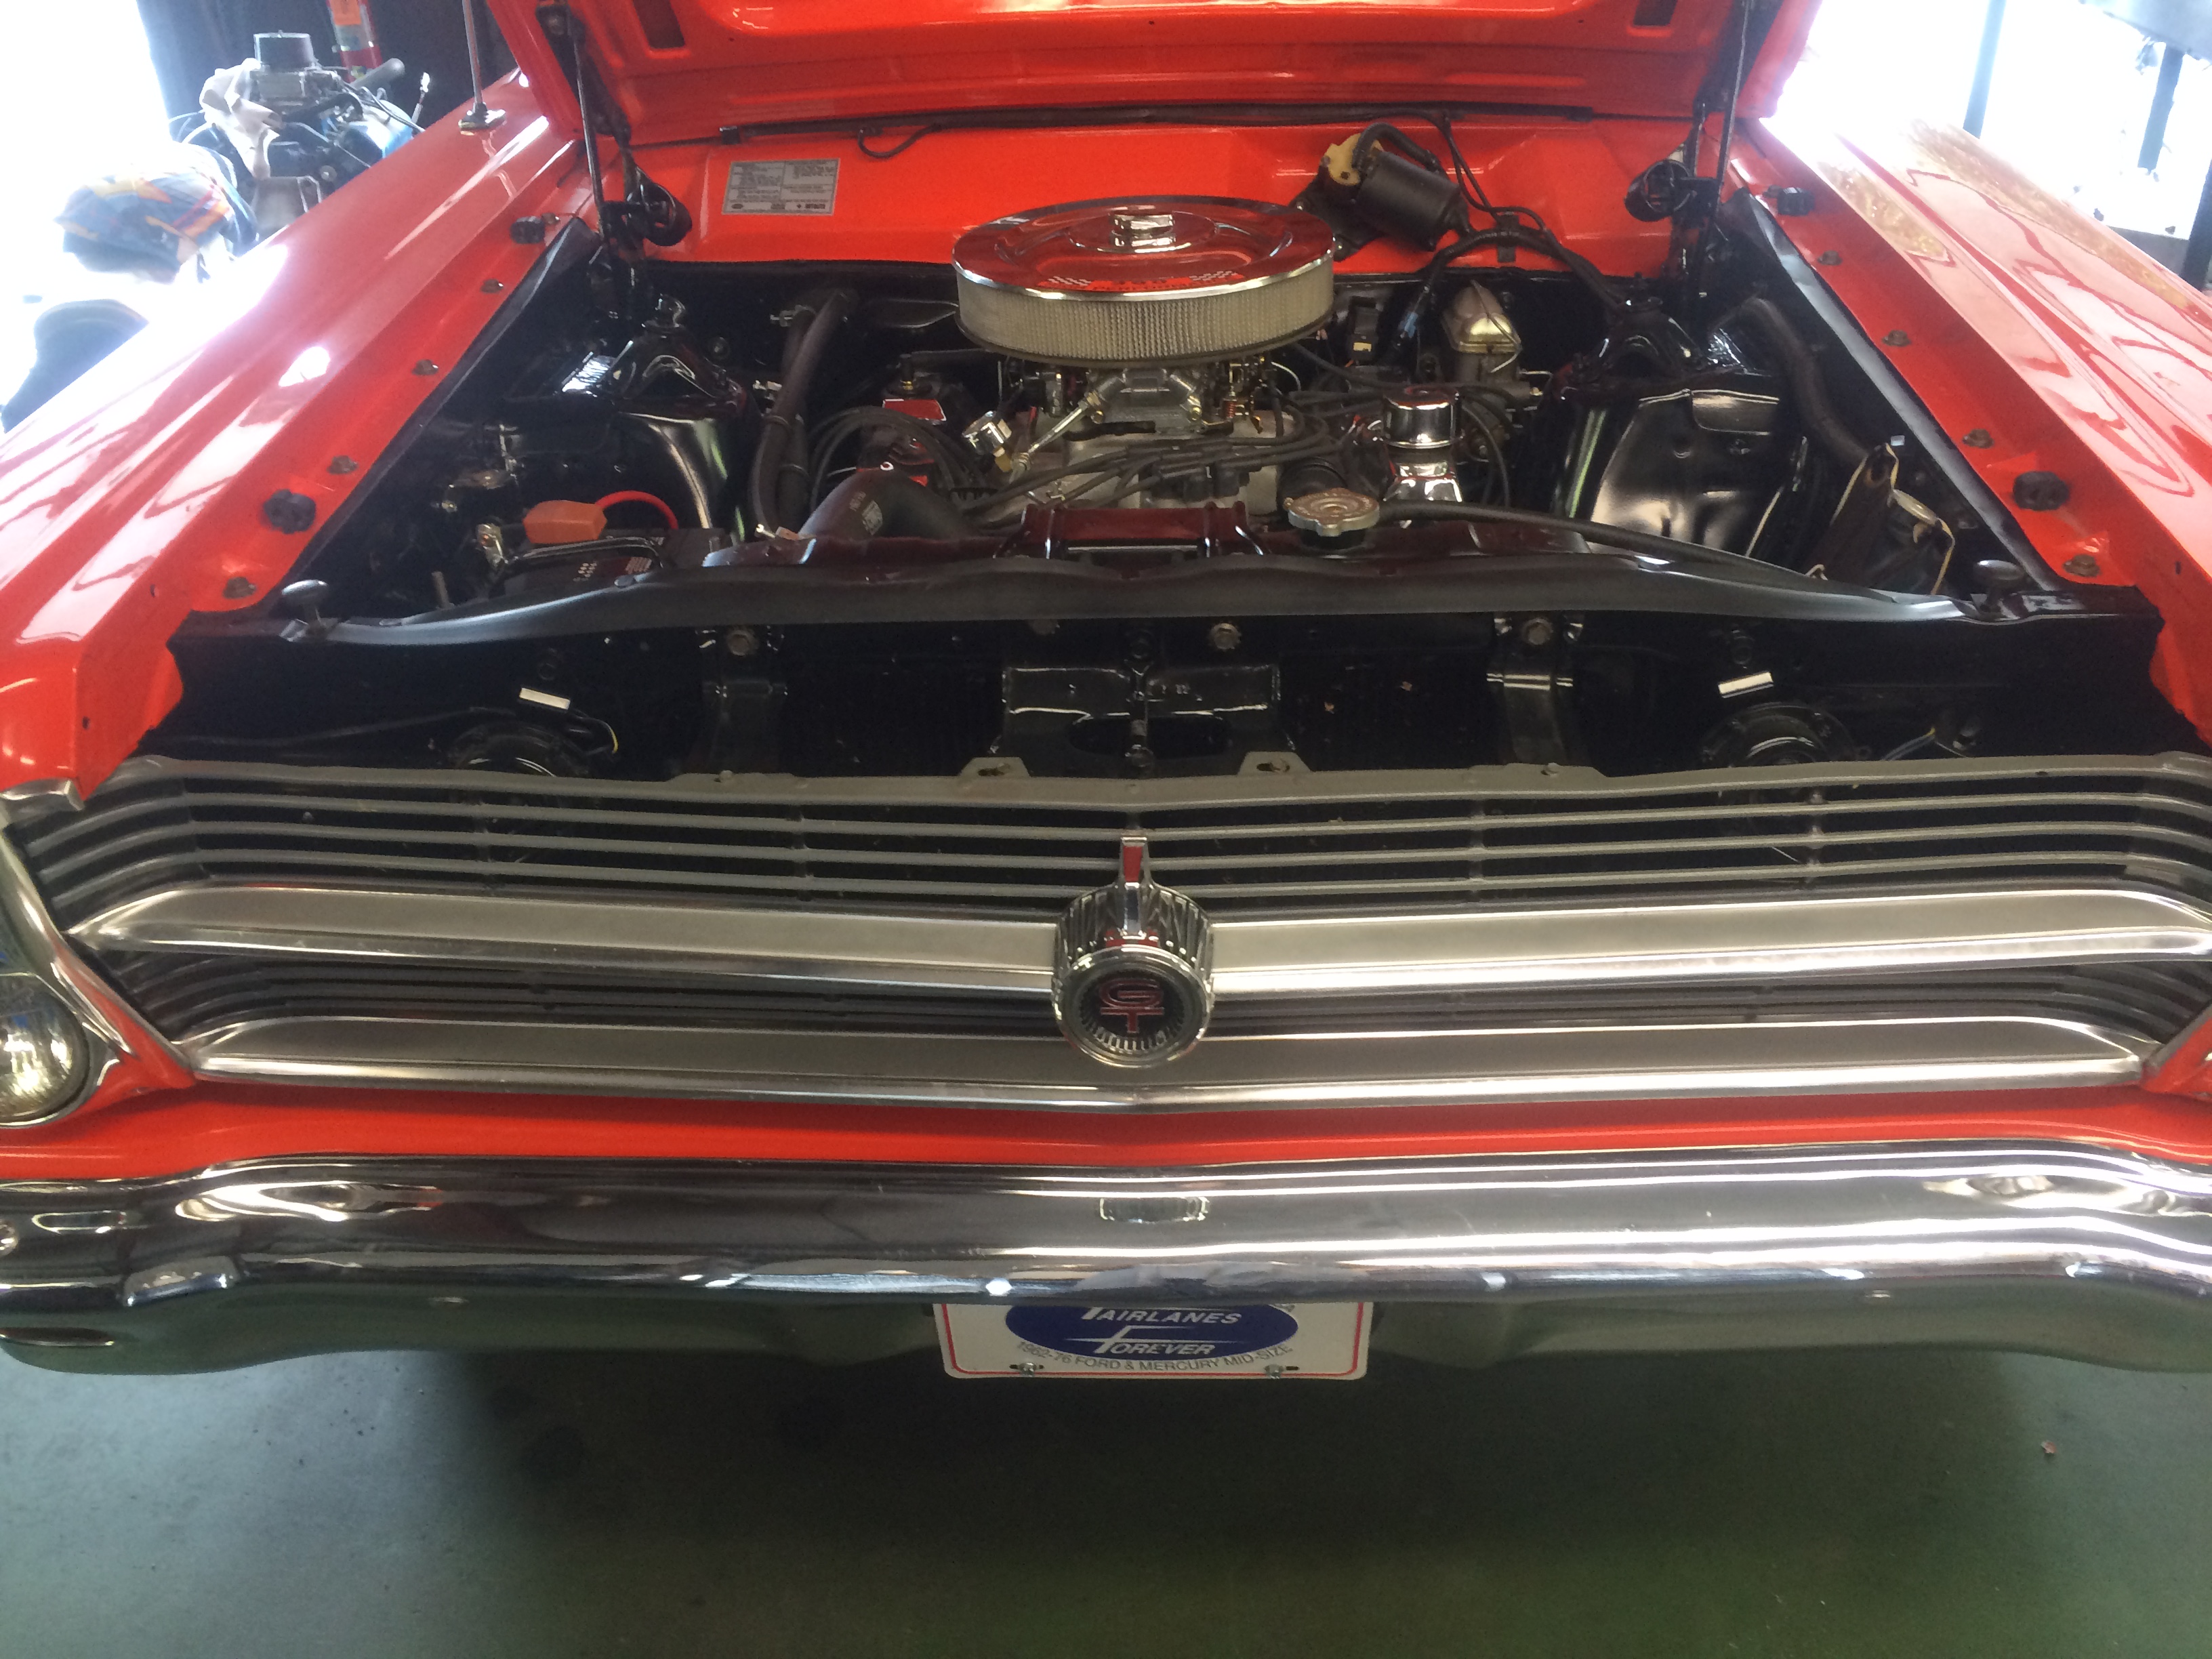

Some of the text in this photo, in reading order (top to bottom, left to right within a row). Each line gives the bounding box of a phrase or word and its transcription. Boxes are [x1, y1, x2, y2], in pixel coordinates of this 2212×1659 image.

[1086, 1325, 1220, 1355] FOREVER
[1076, 1356, 1121, 1370] FORD
[1124, 1361, 1135, 1370] &
[1139, 1358, 1220, 1371] MERCURY
[1223, 1344, 1294, 1366] MID-SIZE
